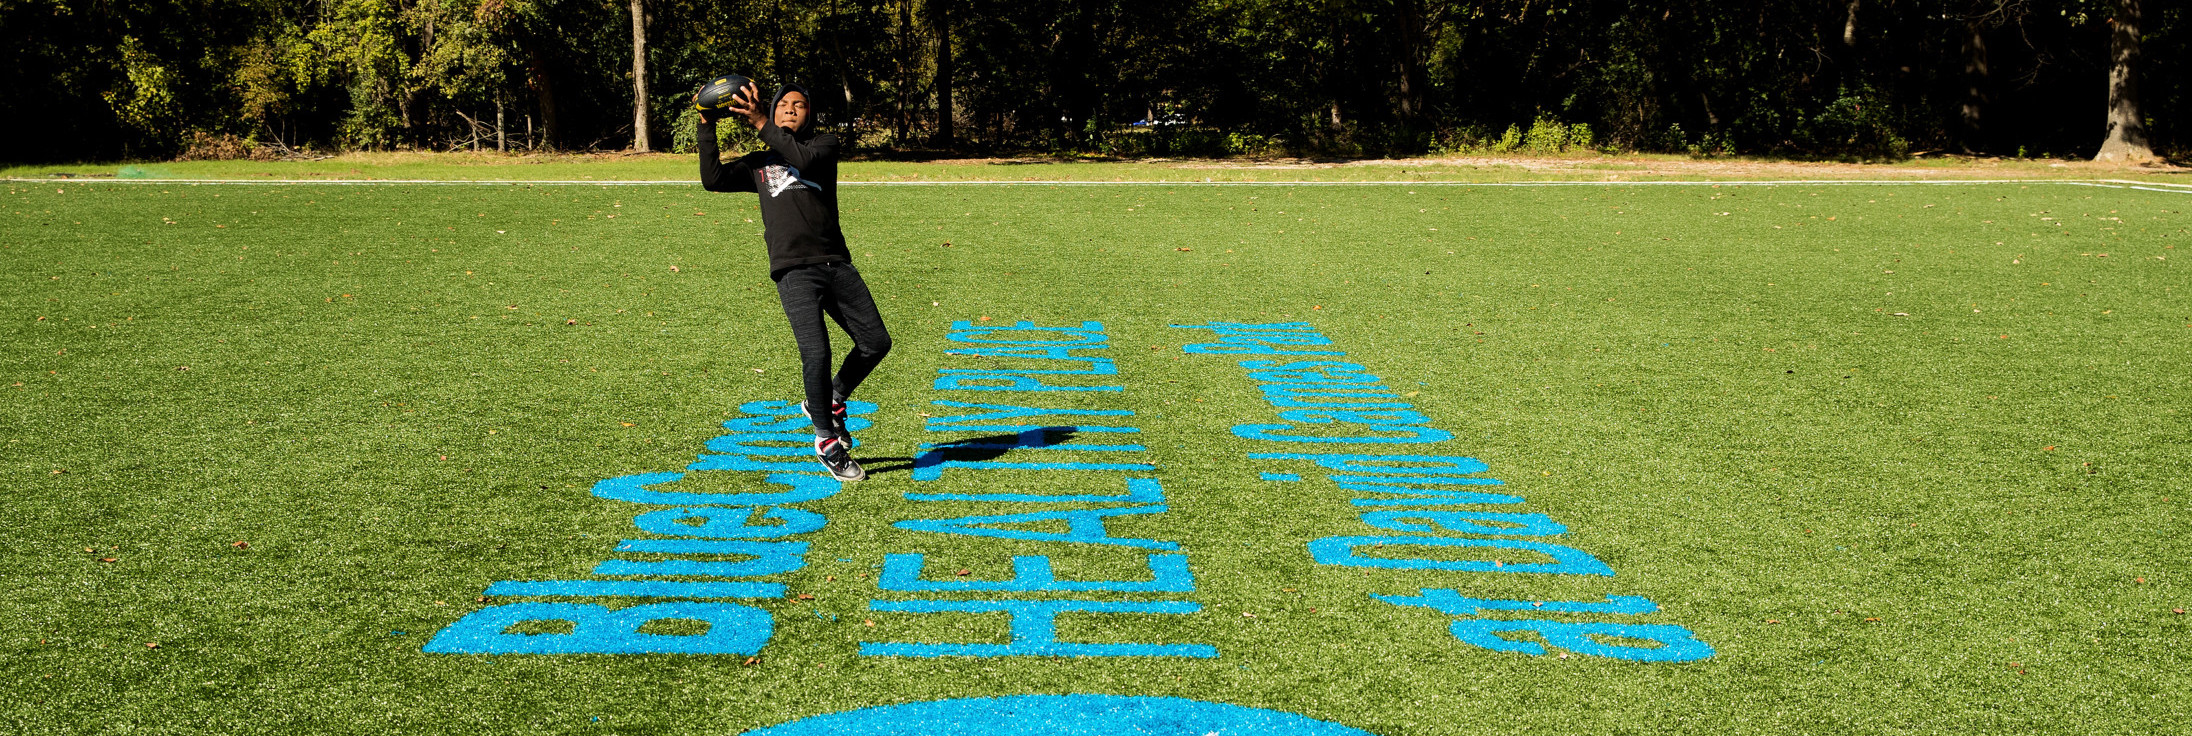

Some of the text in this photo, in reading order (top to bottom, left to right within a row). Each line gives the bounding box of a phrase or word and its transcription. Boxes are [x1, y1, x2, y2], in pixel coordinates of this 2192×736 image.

[422, 399, 878, 656] BlueCross
[859, 320, 1220, 658] HEALTHY PLACE
[1168, 321, 1716, 663] at David Carnes Park
